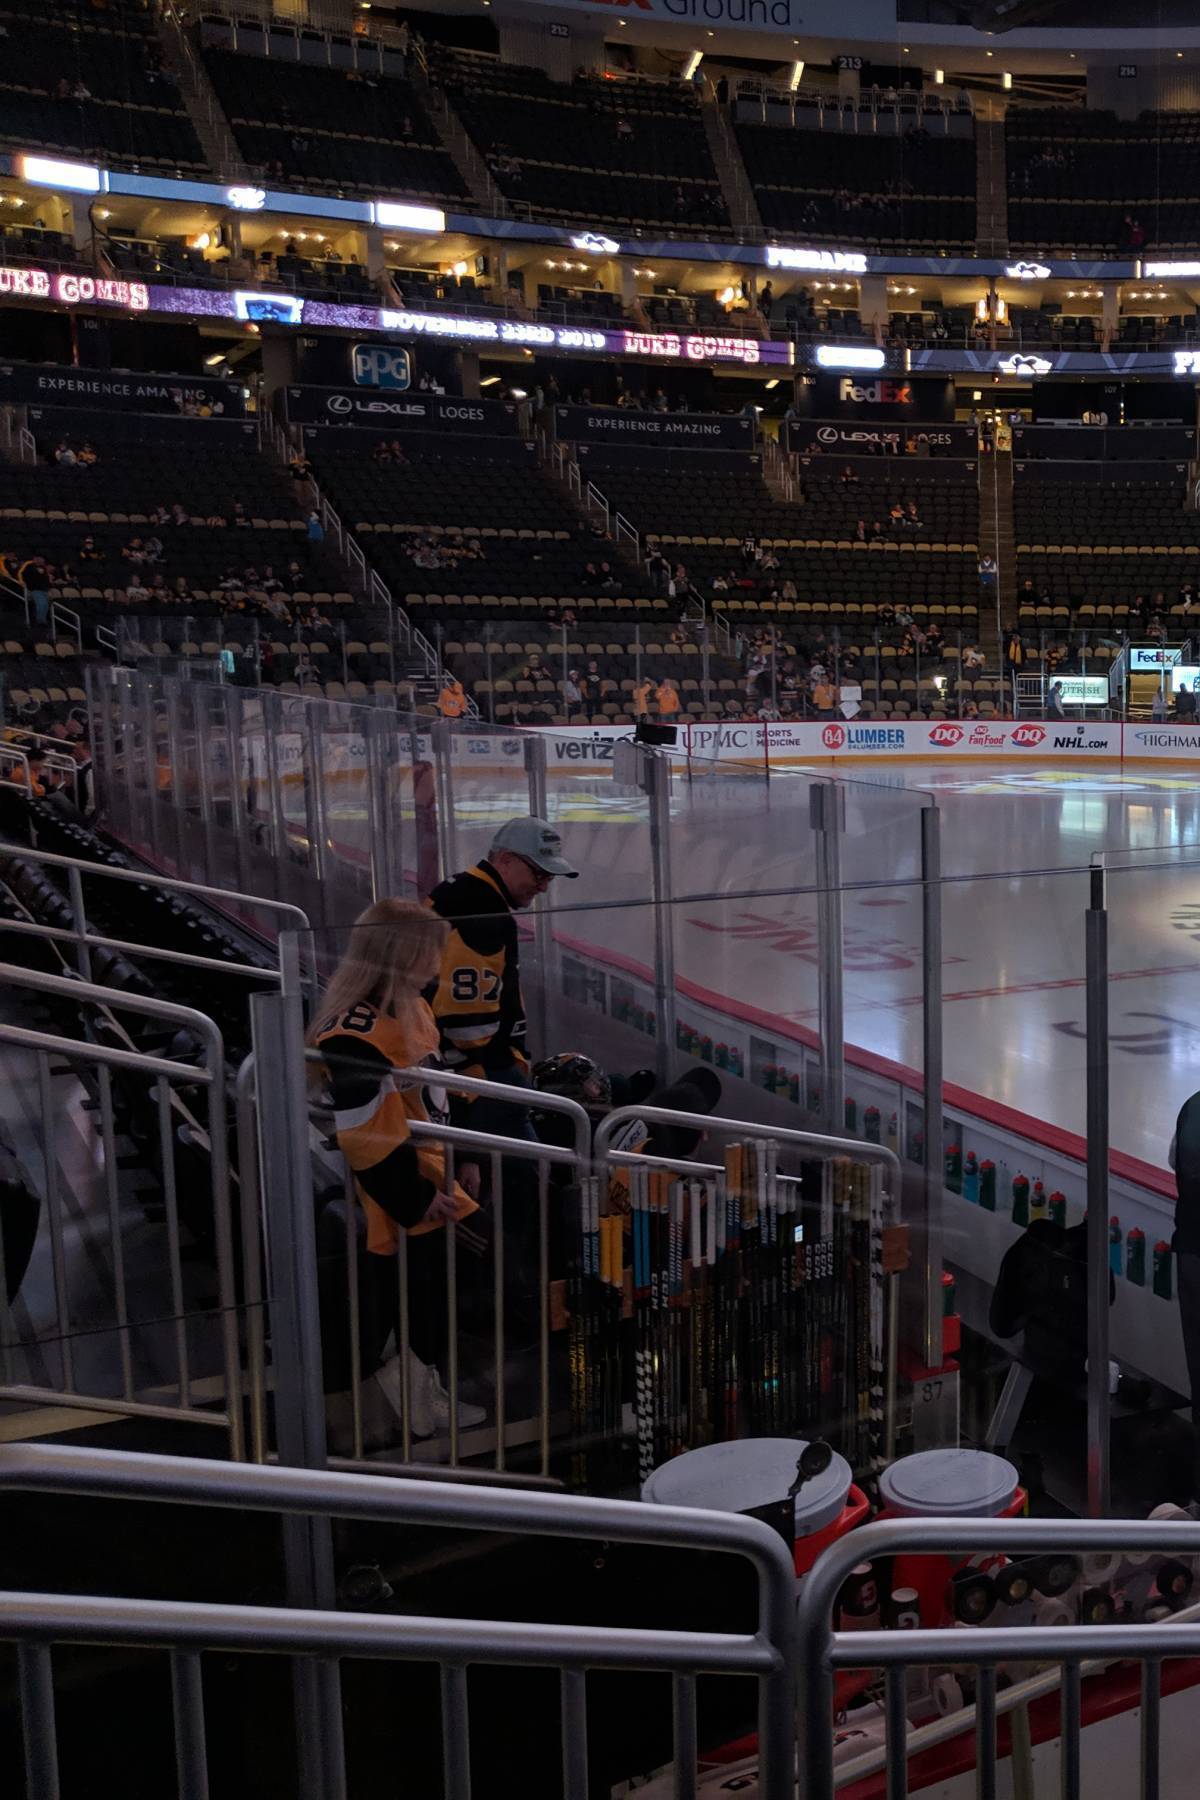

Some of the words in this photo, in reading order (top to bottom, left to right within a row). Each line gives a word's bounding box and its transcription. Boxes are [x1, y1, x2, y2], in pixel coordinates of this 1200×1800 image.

[664, 0, 791, 26] Ground
[839, 56, 863, 70] 213
[356, 349, 408, 387] PPG
[38, 376, 131, 398] EXPERIENCE
[840, 378, 912, 403] FedEx
[355, 401, 427, 417] LEXUS
[440, 404, 485, 422] LOGES
[588, 417, 661, 433] EXPERIENCE
[665, 421, 721, 436] AMAZING
[915, 432, 952, 446] OGES
[1137, 650, 1172, 663] FedEx
[682, 730, 748, 750] UPMC
[756, 729, 792, 738] SPORTS
[756, 738, 801, 747] MEDICINE
[824, 728, 844, 745] 84
[847, 728, 905, 744] LUMBER
[935, 728, 960, 742] DQ
[1016, 728, 1041, 742] DQ
[451, 965, 504, 1003] 87
[921, 1382, 943, 1402] 87
